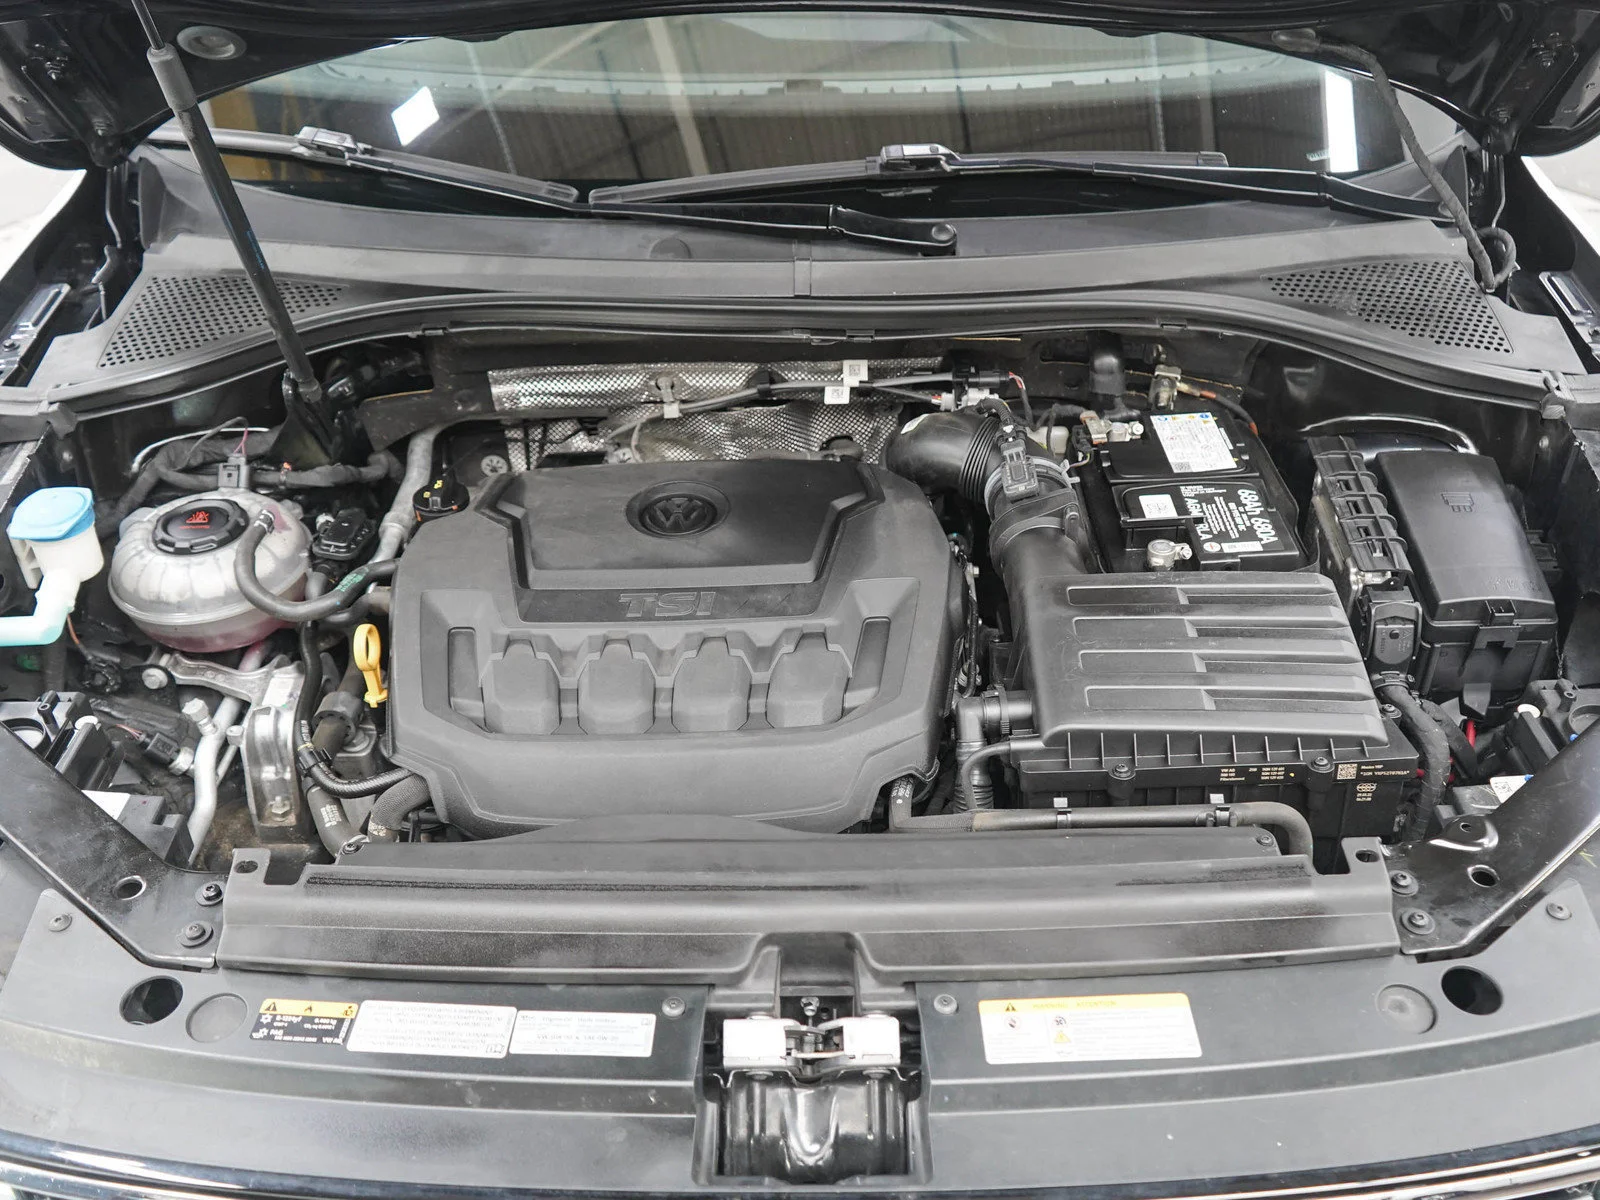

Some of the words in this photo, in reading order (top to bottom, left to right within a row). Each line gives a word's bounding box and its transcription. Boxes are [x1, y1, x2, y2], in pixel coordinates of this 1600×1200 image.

[1238, 489, 1264, 515] 68Ah
[1251, 518, 1278, 544] 680A
[1195, 522, 1213, 541] RLA
[618, 591, 716, 617] TSI
